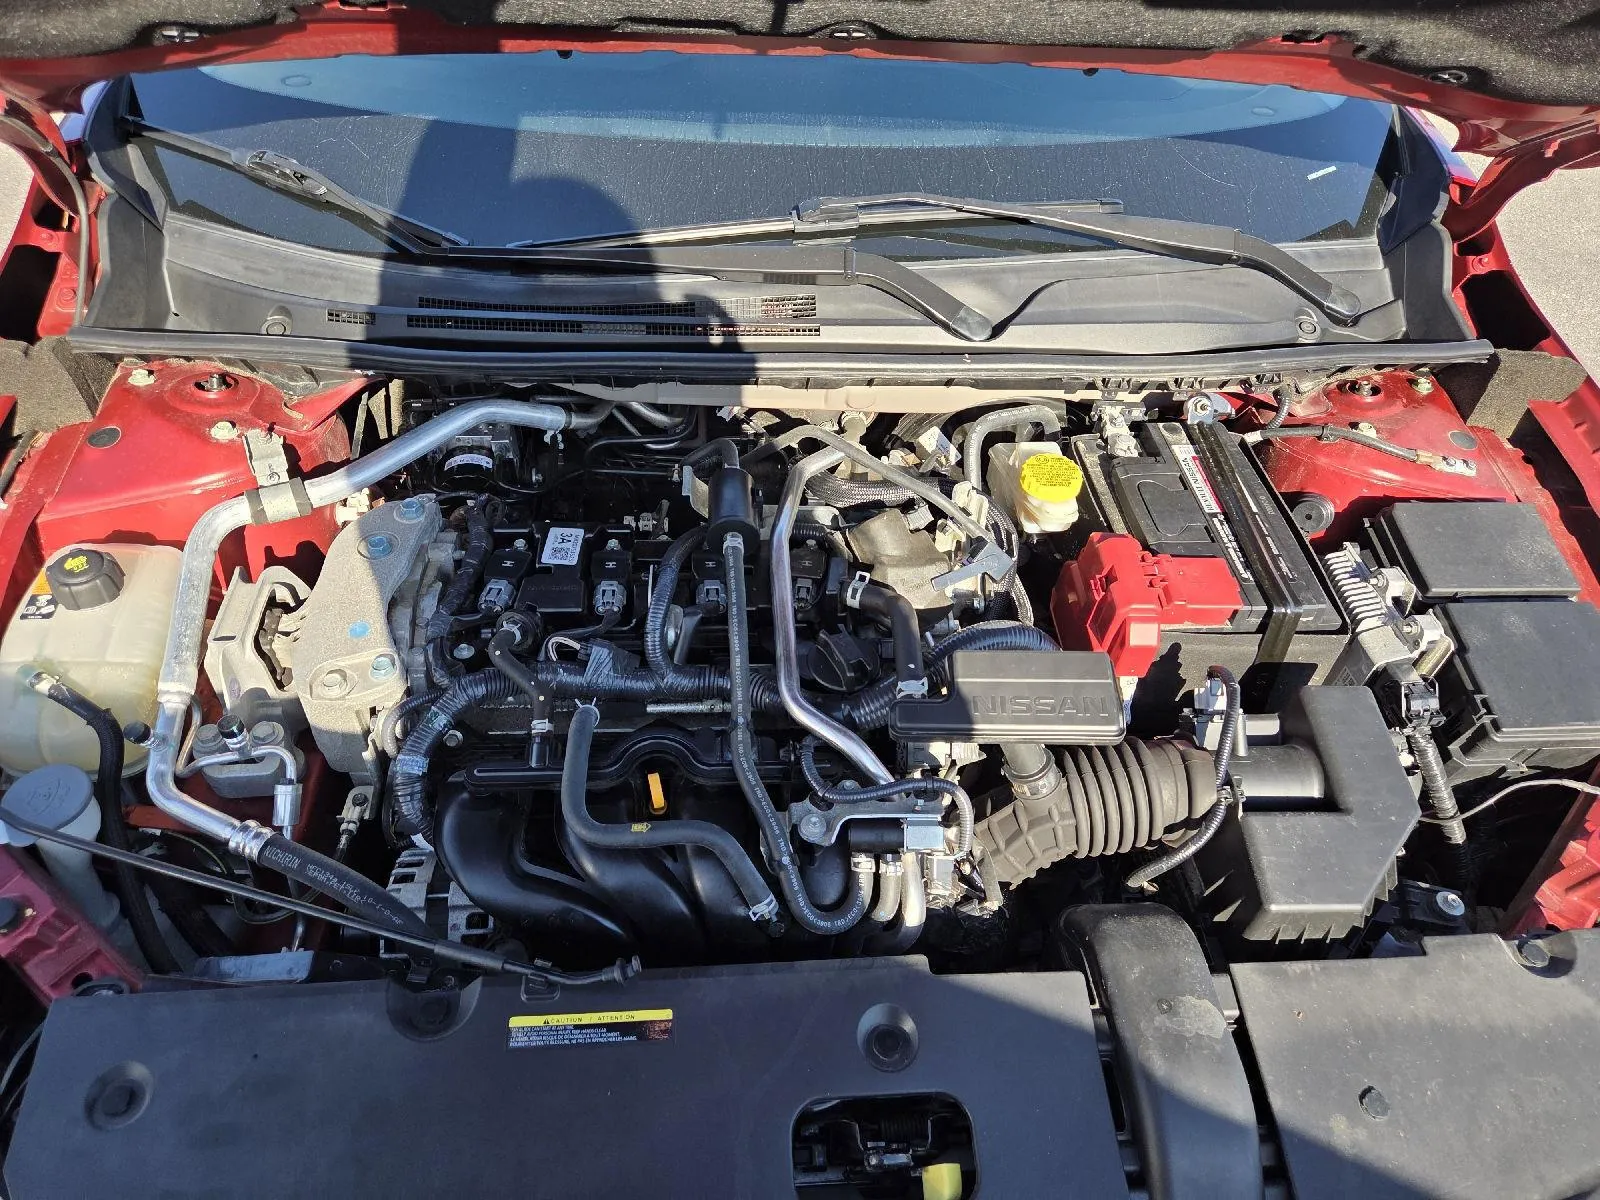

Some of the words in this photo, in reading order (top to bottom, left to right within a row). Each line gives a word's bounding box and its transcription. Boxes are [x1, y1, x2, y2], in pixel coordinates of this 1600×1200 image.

[558, 532, 573, 545] 3A
[972, 695, 1109, 717] NISSAN
[264, 845, 302, 869] NICHIRIN
